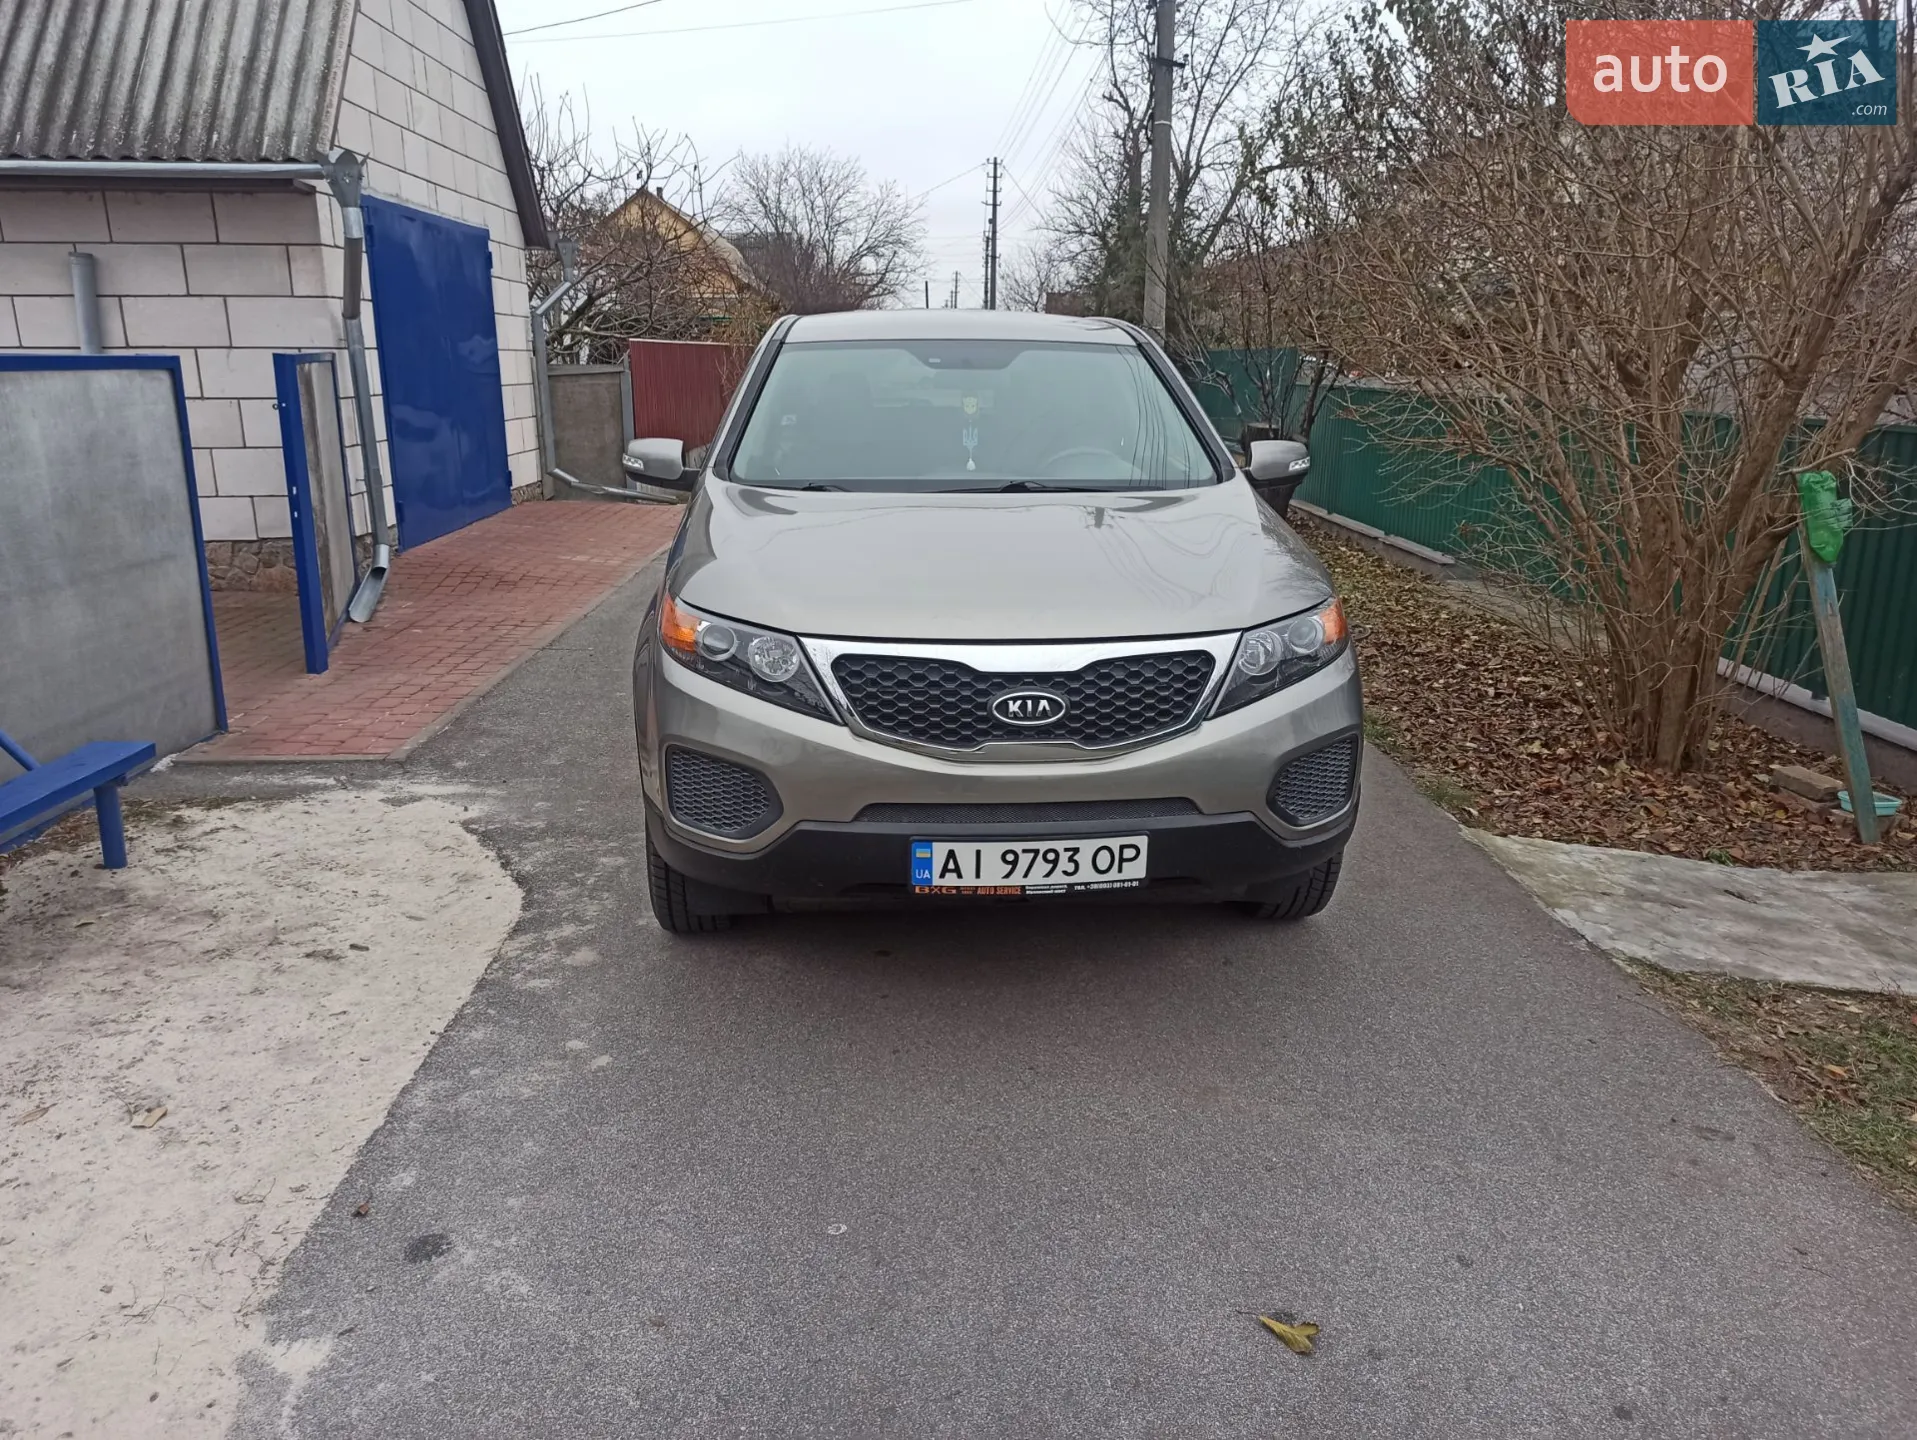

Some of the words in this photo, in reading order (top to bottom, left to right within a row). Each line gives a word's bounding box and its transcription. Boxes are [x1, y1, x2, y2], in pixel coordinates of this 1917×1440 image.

[1007, 699, 1053, 718] KIA
[938, 848, 982, 880] AI
[1000, 847, 1081, 880] 9793
[1091, 843, 1141, 876] OP
[915, 869, 931, 879] UA
[976, 886, 994, 895] AUTO
[995, 886, 1022, 895] SERVICE
